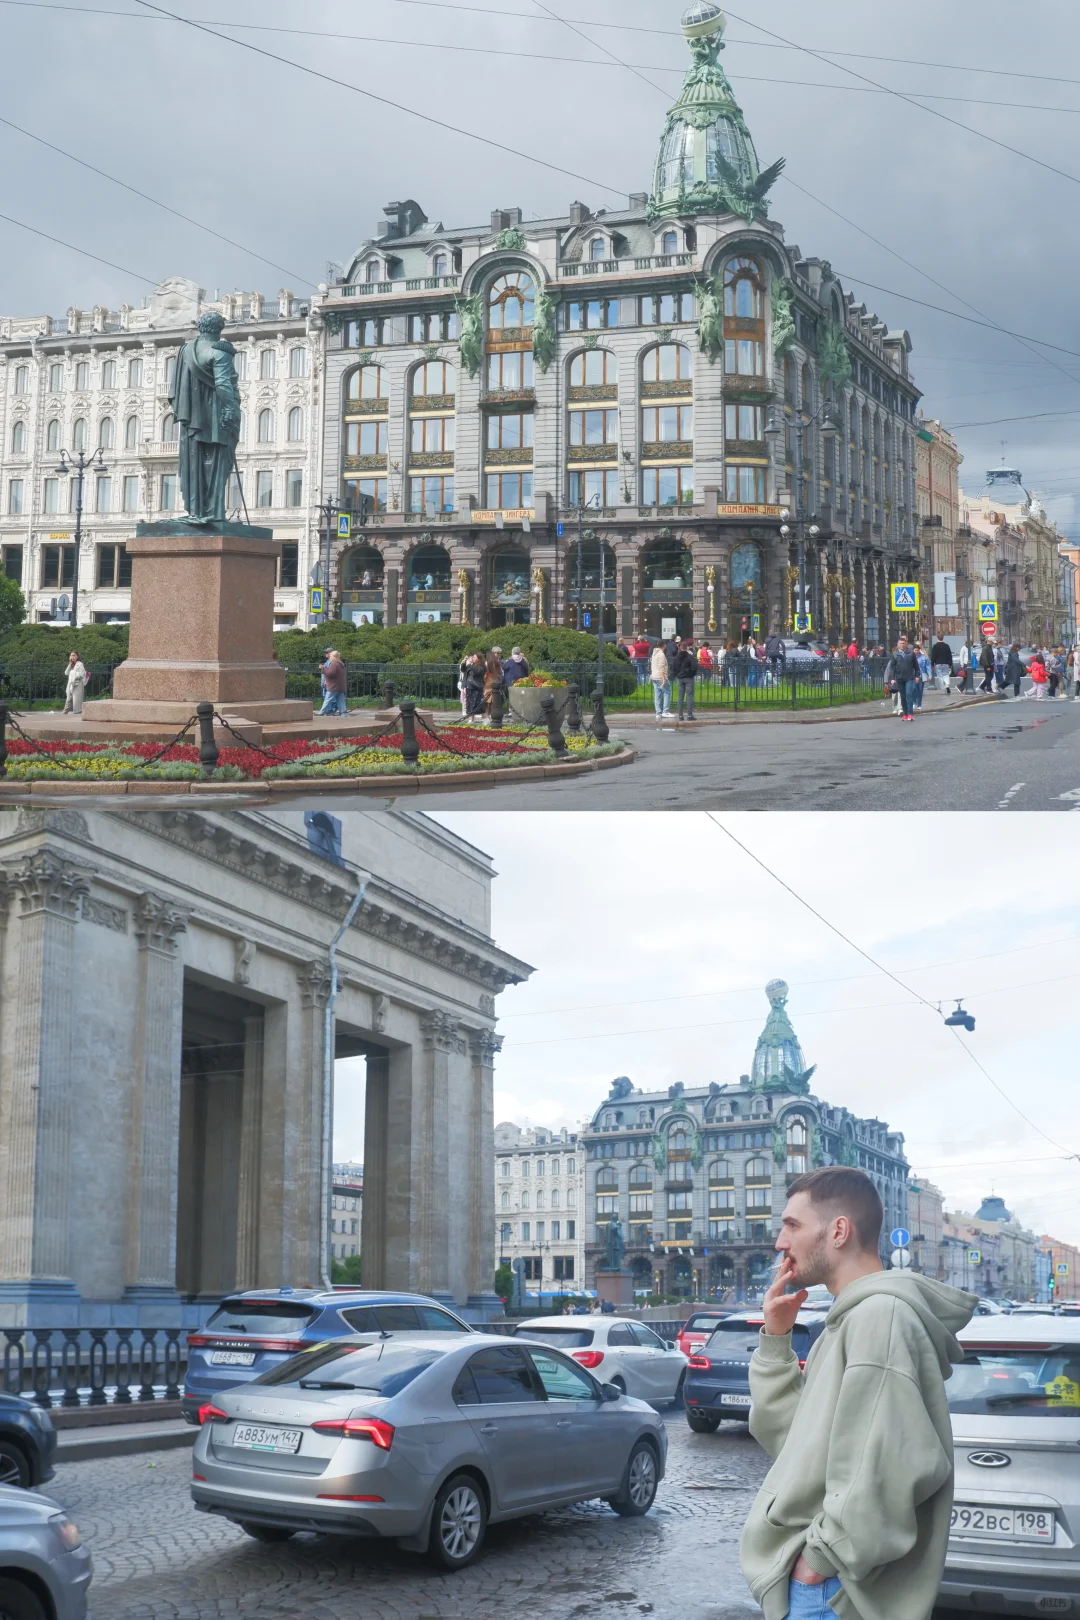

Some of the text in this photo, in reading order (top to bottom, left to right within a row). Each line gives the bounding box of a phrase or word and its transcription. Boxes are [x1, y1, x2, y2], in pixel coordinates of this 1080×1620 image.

[281, 1431, 298, 1442] 147
[950, 1508, 1046, 1531] 992ВС 198
